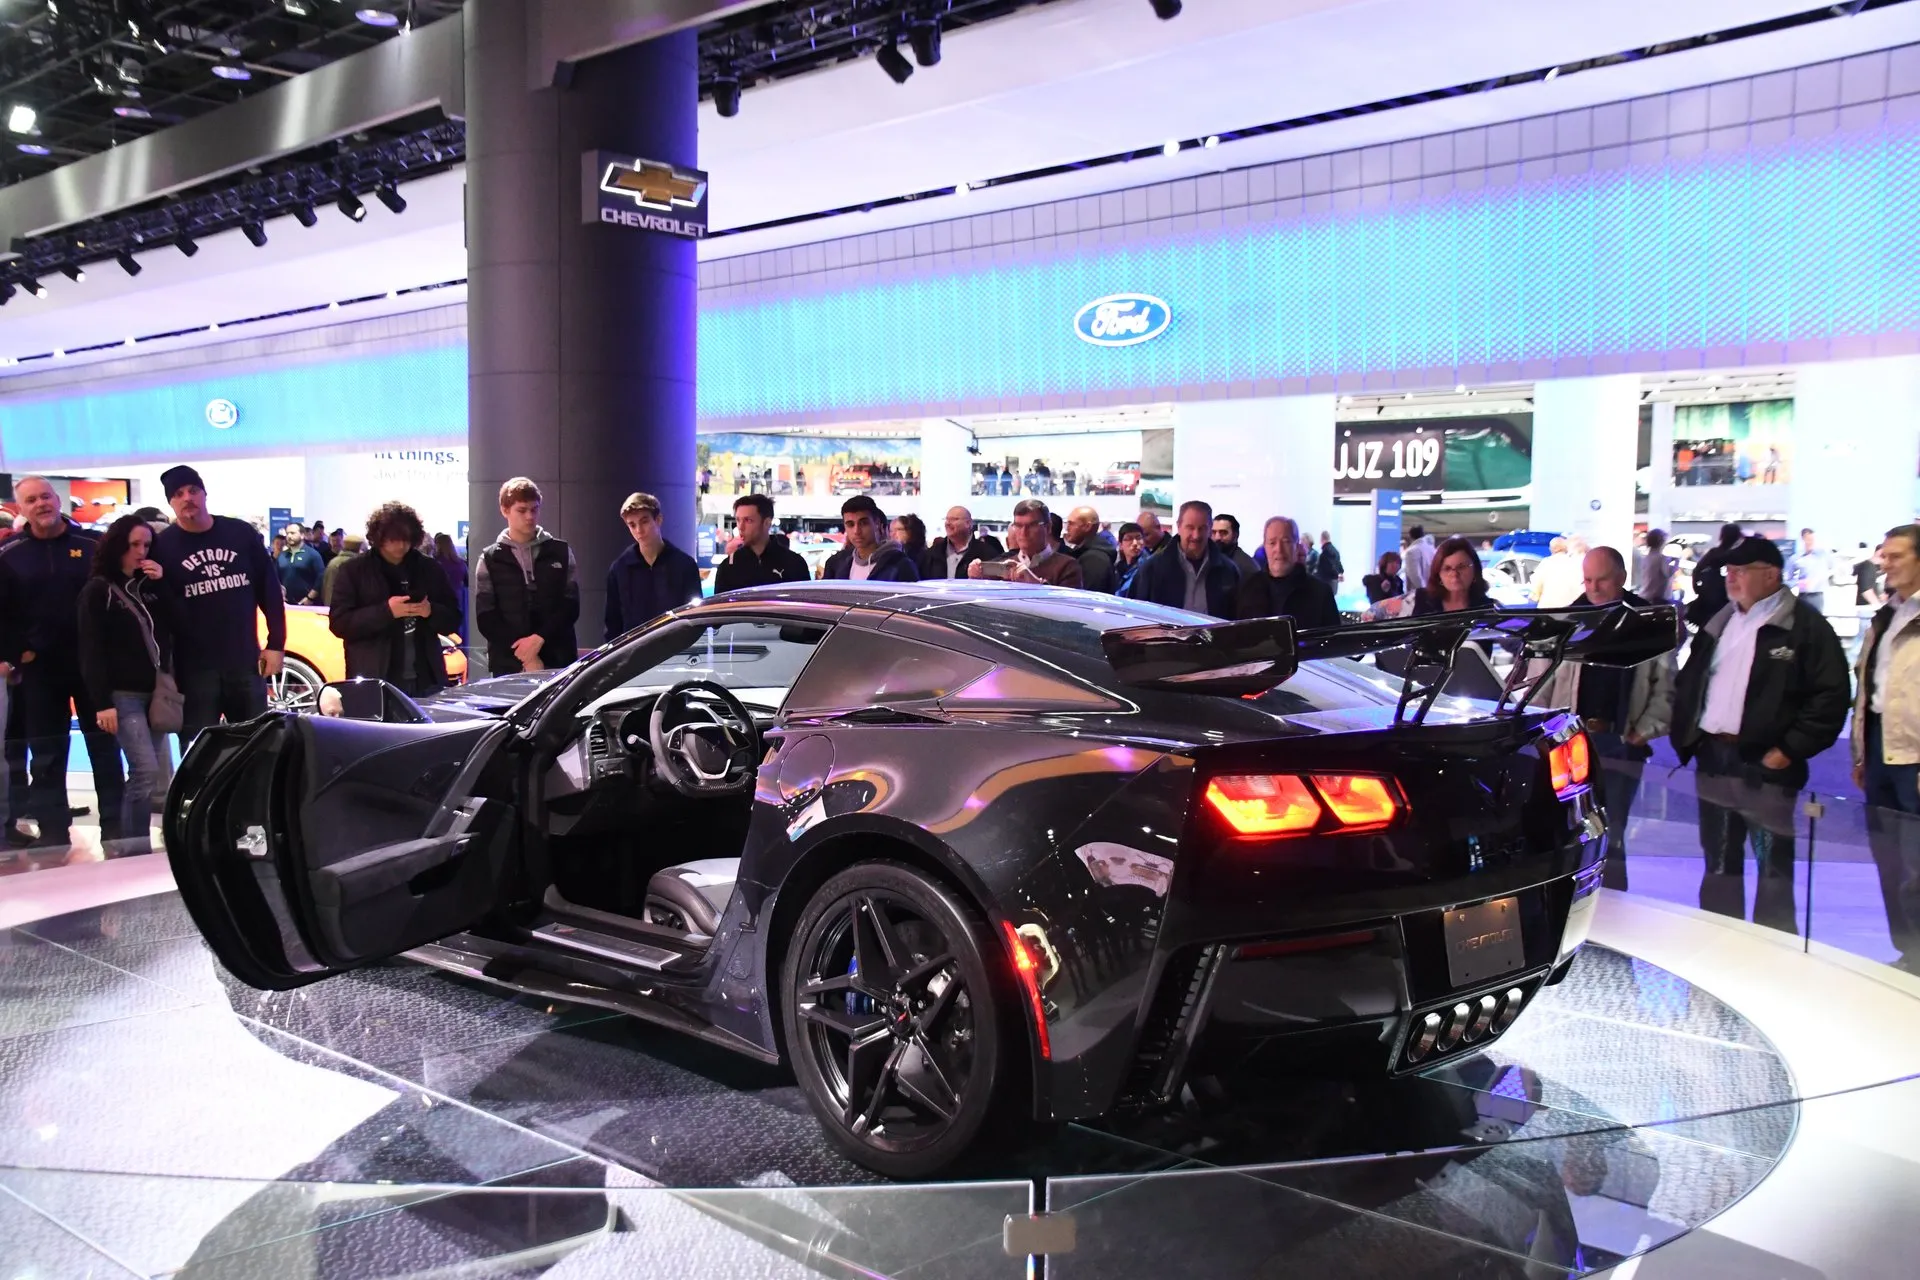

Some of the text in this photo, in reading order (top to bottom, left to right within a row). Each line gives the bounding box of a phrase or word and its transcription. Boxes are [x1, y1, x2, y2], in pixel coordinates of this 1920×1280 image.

[601, 207, 706, 237] CHEVROLET
[1091, 301, 1150, 337] Ford
[1389, 438, 1440, 478] 109
[181, 548, 238, 571] DETROIT
